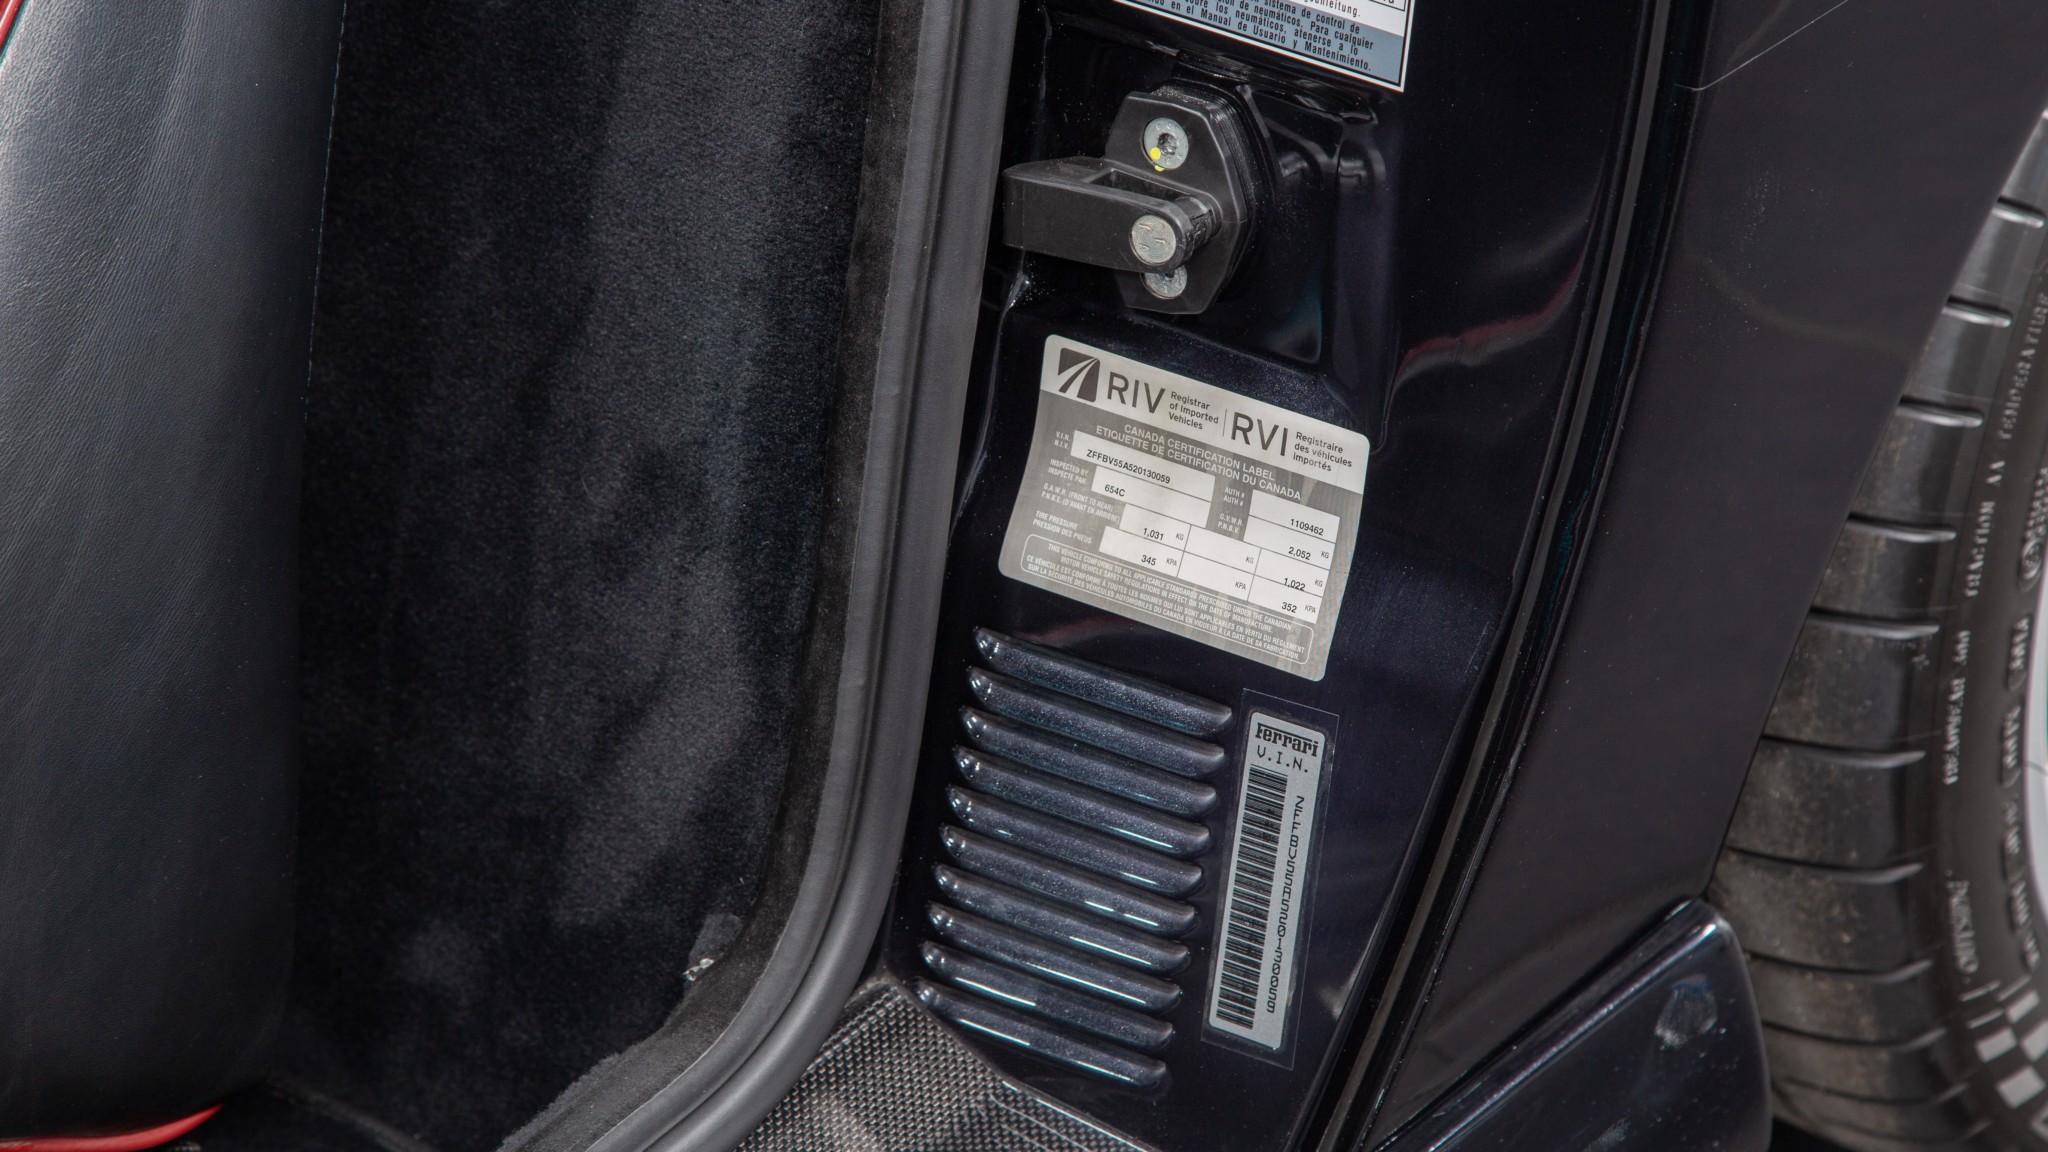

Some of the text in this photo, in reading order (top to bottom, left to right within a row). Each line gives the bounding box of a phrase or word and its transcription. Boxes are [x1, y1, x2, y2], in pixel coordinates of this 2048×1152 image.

[1215, 1, 1228, 14] los
[1235, 7, 1286, 33] neumáticos,
[1294, 28, 1331, 47] atenerse
[1339, 41, 1343, 51] a
[1350, 45, 1358, 55] lo
[1239, 0, 1249, 11] de
[1254, 4, 1303, 28] neumáticos.
[1310, 21, 1328, 35] Para
[1334, 28, 1373, 51] cualquier
[1301, 7, 1311, 19] de
[1315, 11, 1345, 29] control
[1350, 22, 1360, 34] de
[1171, 0, 1180, 10] en
[1186, 3, 1194, 14] el
[1200, 8, 1231, 26] Manual
[1237, 19, 1247, 31] de
[1253, 24, 1285, 43] Usuario
[1292, 39, 1297, 49] y
[1304, 40, 1371, 71] Mantenimiento.
[1106, 371, 1166, 414] RIV
[1169, 390, 1210, 412] Registrar
[1167, 411, 1203, 429] Vehicles
[1168, 400, 1219, 424] of Imported
[1230, 411, 1289, 456] RVI
[1295, 431, 1343, 455] Registraire
[1123, 423, 1275, 481] CANADA CERTIFICATION LABEL
[1292, 451, 1332, 472] importés
[1293, 441, 1353, 467] des véhicules
[1049, 458, 1088, 477] INSPECTED BY
[1086, 448, 1170, 484] ZFFBV55A520130059
[1095, 425, 1301, 500] ETIQUETTE DE CERTIFICATION DU CANADA
[1104, 483, 1125, 497] 654C
[1224, 486, 1239, 497] AUTH
[1222, 495, 1238, 505] AUTH
[1035, 510, 1077, 530] TIRE PRESSURE
[1289, 517, 1324, 536] 1109462
[1142, 527, 1164, 541] 1,031
[1175, 532, 1184, 541] KG
[1140, 554, 1156, 566] 345
[1165, 557, 1177, 567] KPA
[1245, 555, 1254, 564] KG
[1287, 545, 1311, 561] 2,052
[1320, 550, 1329, 559] KG
[1234, 581, 1246, 590] KPA
[1283, 577, 1305, 592] 1,022
[1314, 579, 1323, 587] KG
[1281, 601, 1297, 613] 352
[1304, 604, 1316, 614] KPA
[1255, 722, 1319, 758] Ferrari
[1257, 744, 1308, 773] V.I.N.
